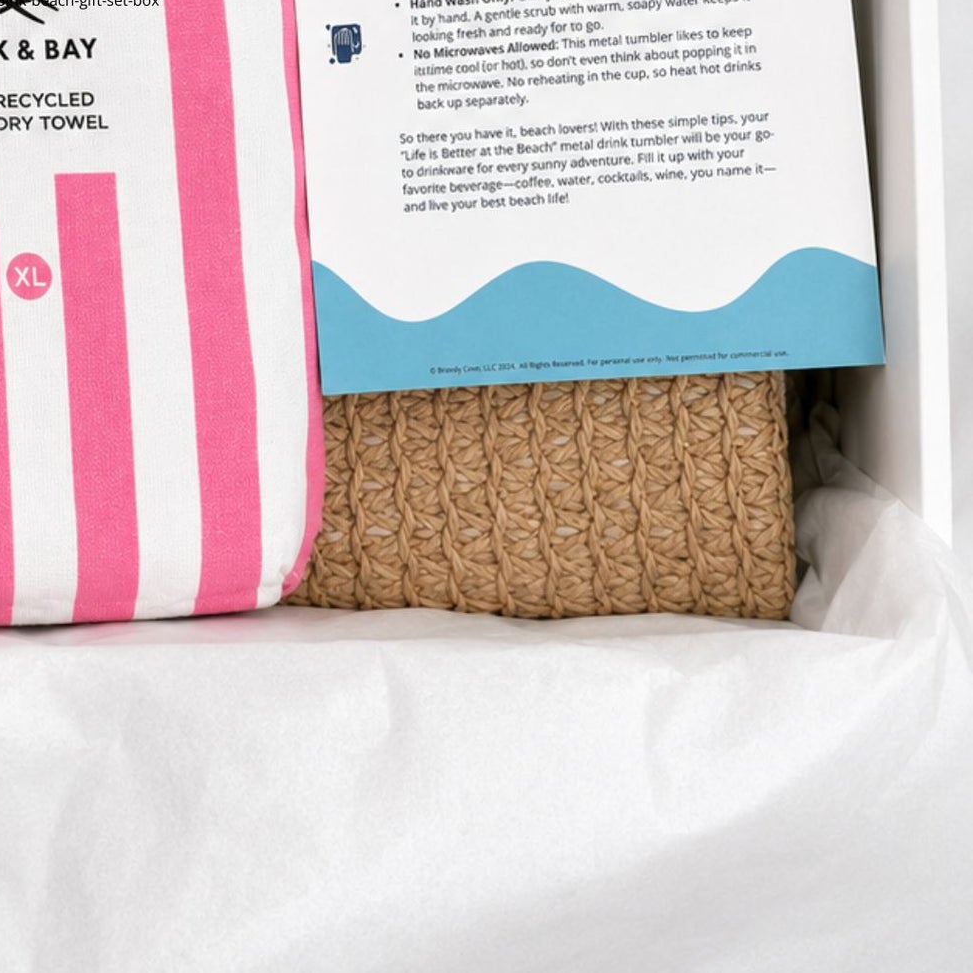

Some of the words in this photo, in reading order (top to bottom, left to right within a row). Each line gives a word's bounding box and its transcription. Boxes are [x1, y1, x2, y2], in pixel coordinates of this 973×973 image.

[437, 11, 471, 23] hand.
[524, 6, 556, 18] scrub
[627, 0, 662, 11] soapy
[17, 39, 34, 60] &
[45, 37, 97, 59] BAY
[414, 49, 430, 59] No
[434, 45, 505, 58] Microwaves
[507, 39, 559, 53] Allowed:
[722, 27, 752, 39] keep
[527, 73, 585, 86] reheating
[465, 93, 529, 109] separately.
[39, 114, 109, 130] TOWEL
[417, 133, 447, 143] there
[450, 132, 472, 144] you
[520, 125, 556, 137] beach
[668, 115, 708, 128] simple
[560, 139, 593, 151] metal
[630, 134, 679, 147] tumbler
[724, 131, 751, 144] your
[687, 149, 714, 161] with
[717, 149, 744, 162] your
[403, 183, 446, 195] favorite
[14, 266, 47, 287] XL
